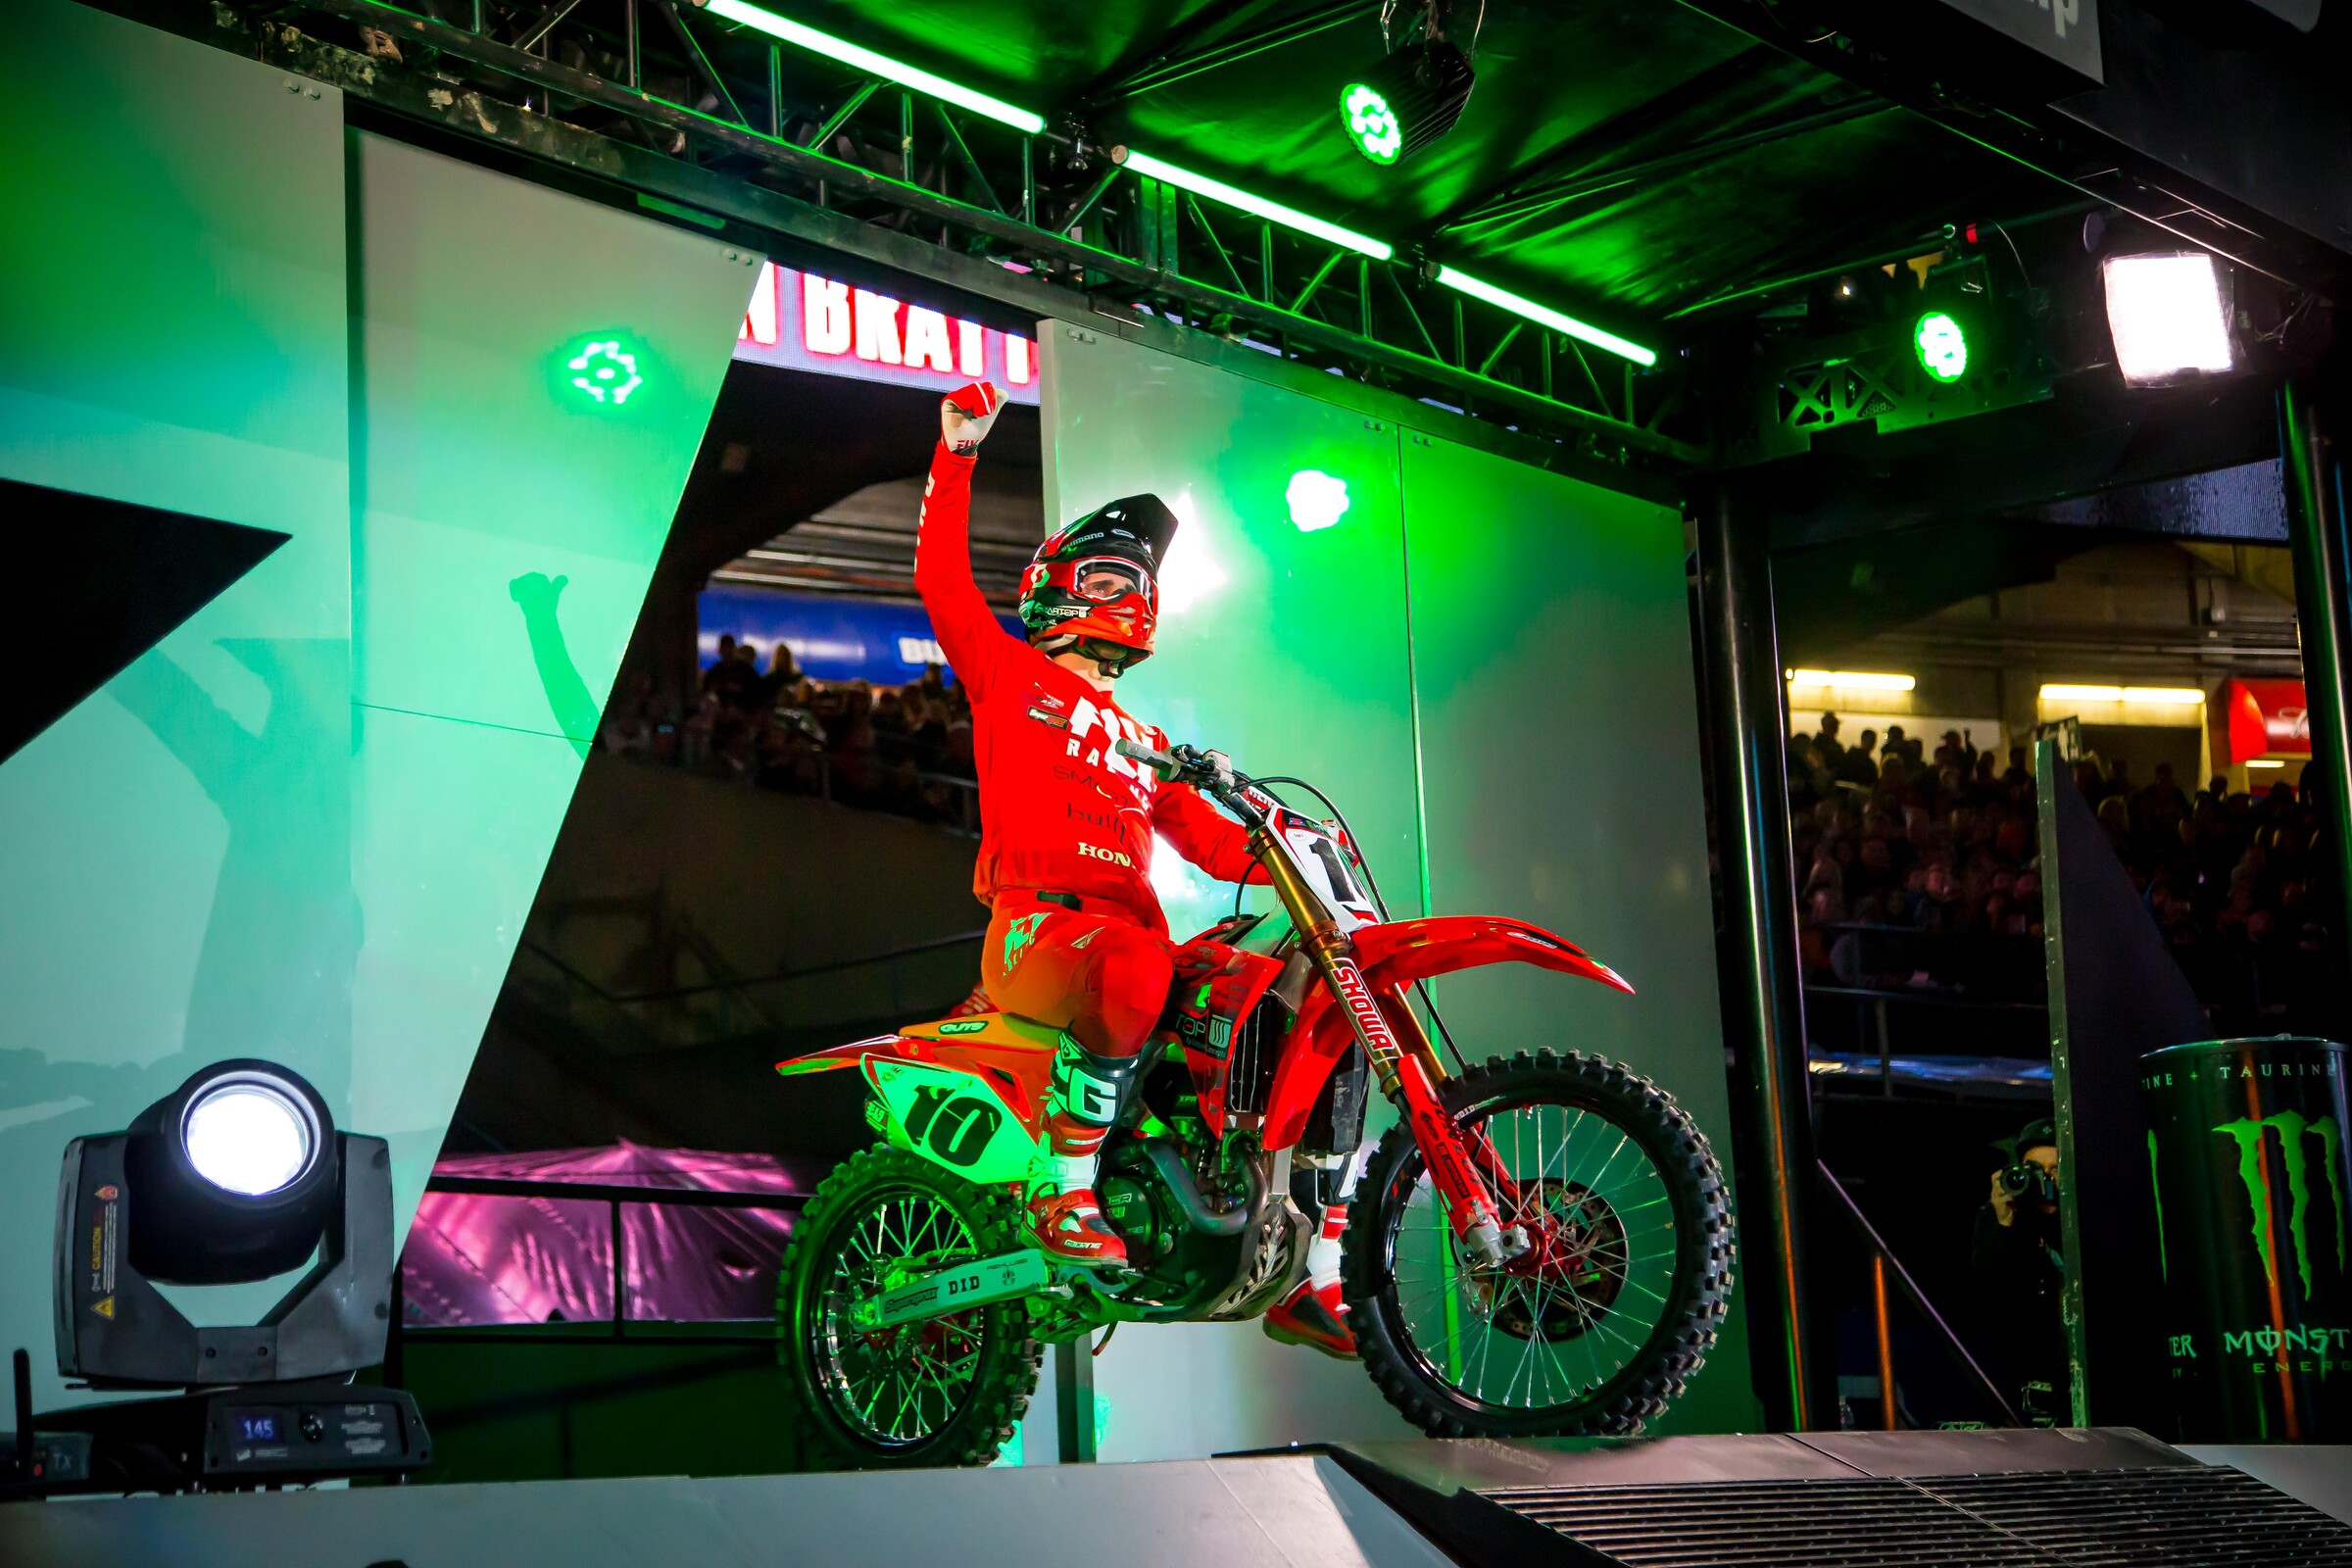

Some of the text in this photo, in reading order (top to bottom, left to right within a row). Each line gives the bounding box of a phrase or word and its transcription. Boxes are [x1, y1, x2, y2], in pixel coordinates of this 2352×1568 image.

[1078, 842, 1132, 867] HON
[1308, 837, 1367, 903] 1
[1330, 967, 1396, 1052] SHOWA
[940, 1021, 986, 1033] GUTS
[904, 1084, 1003, 1167] 10
[92, 1226, 102, 1270] CAUTION
[2169, 1334, 2197, 1358] ER
[244, 1419, 274, 1440] 145
